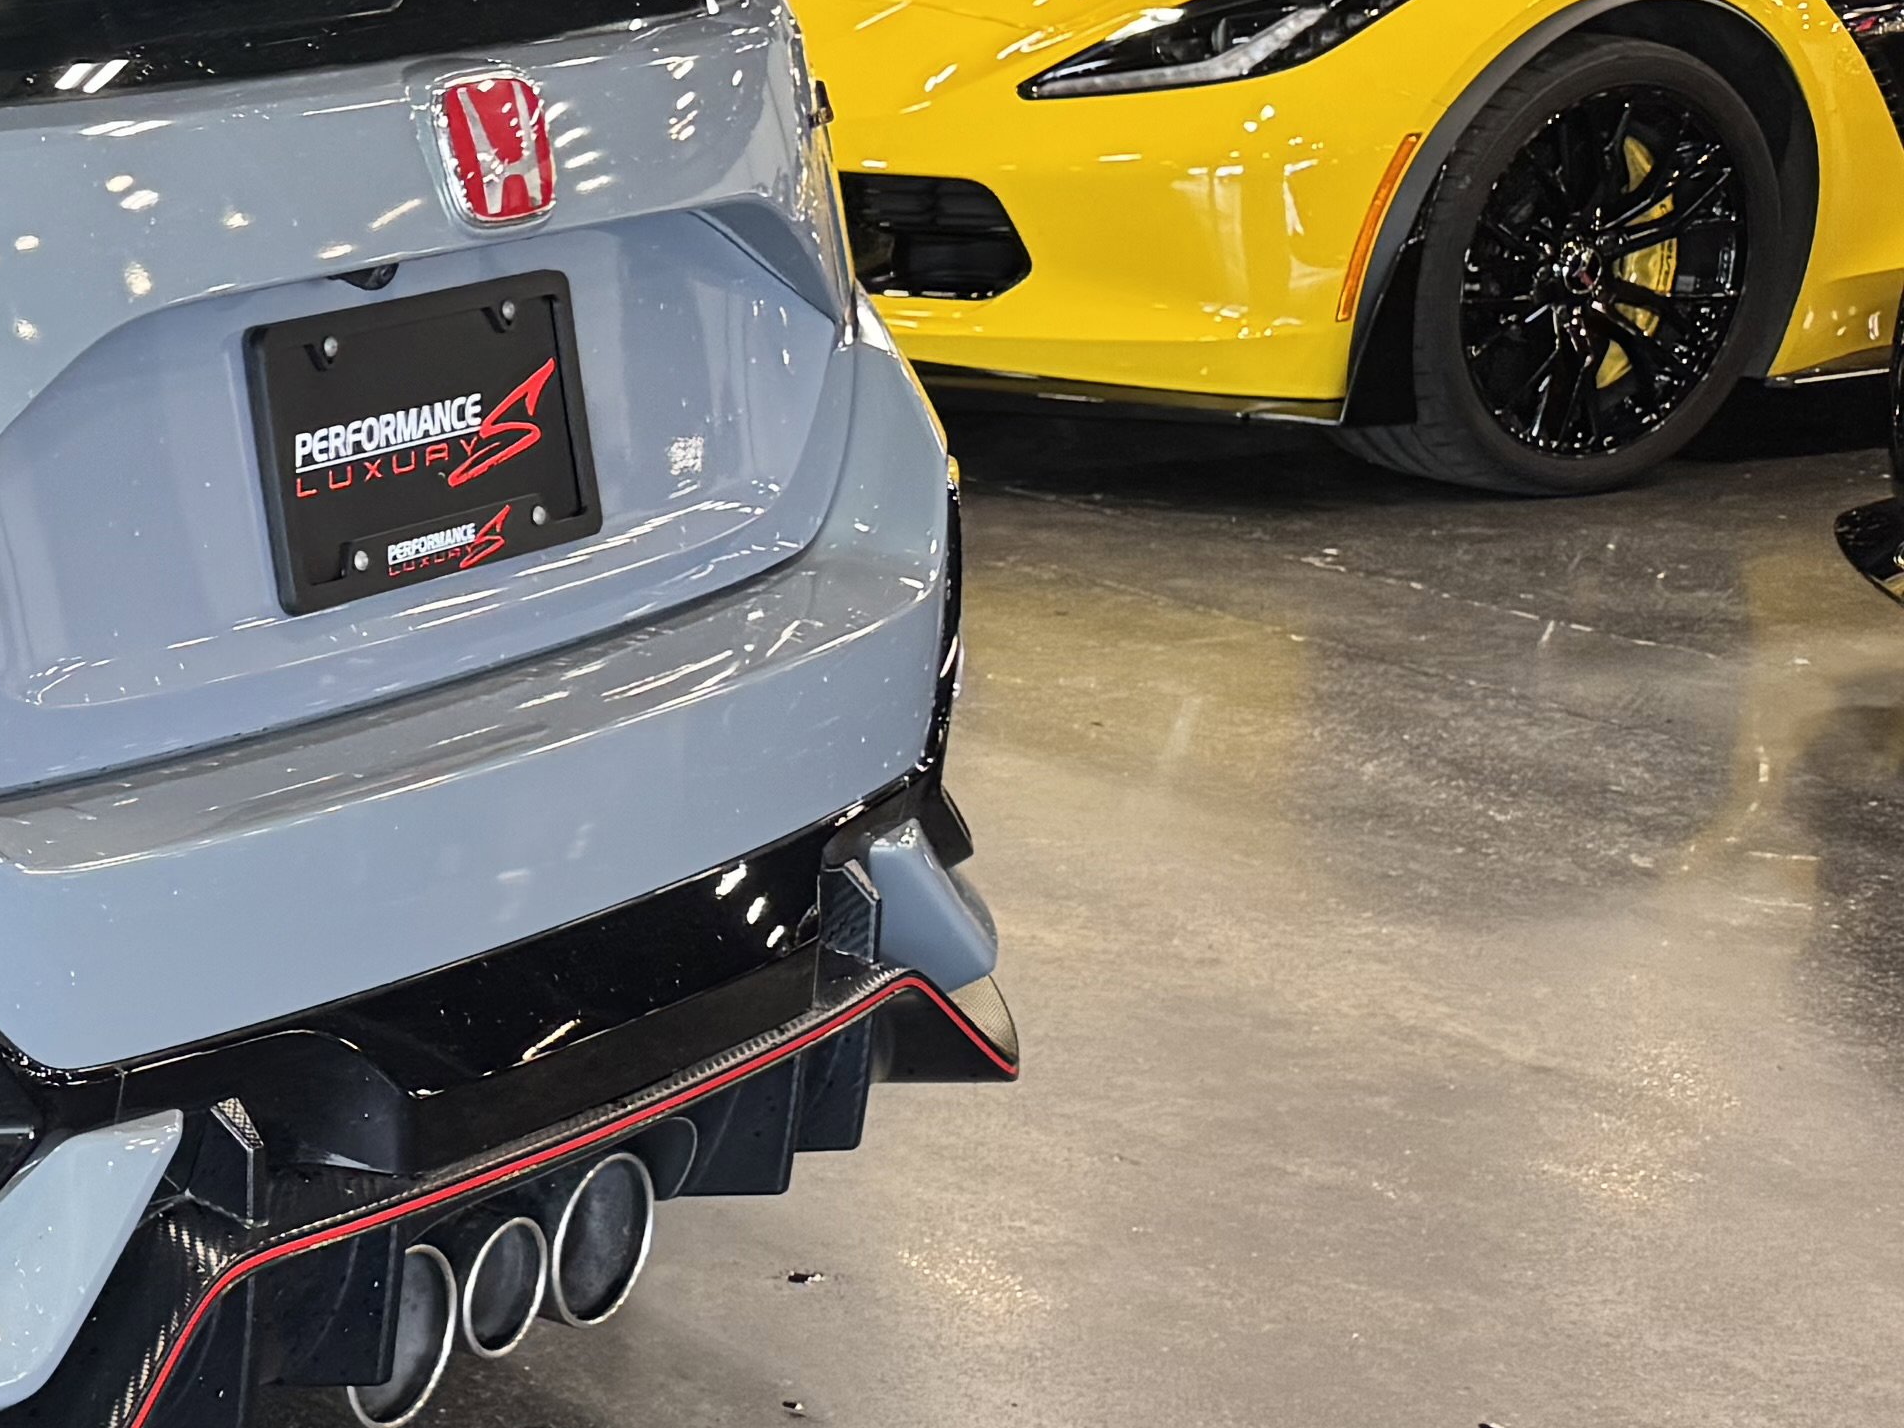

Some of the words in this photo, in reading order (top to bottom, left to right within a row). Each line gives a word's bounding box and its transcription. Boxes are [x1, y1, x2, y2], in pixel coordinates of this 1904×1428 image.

[295, 393, 482, 468] PERFORMANCE
[296, 436, 479, 498] LUXURY
[387, 523, 476, 563] PERFORMANCE
